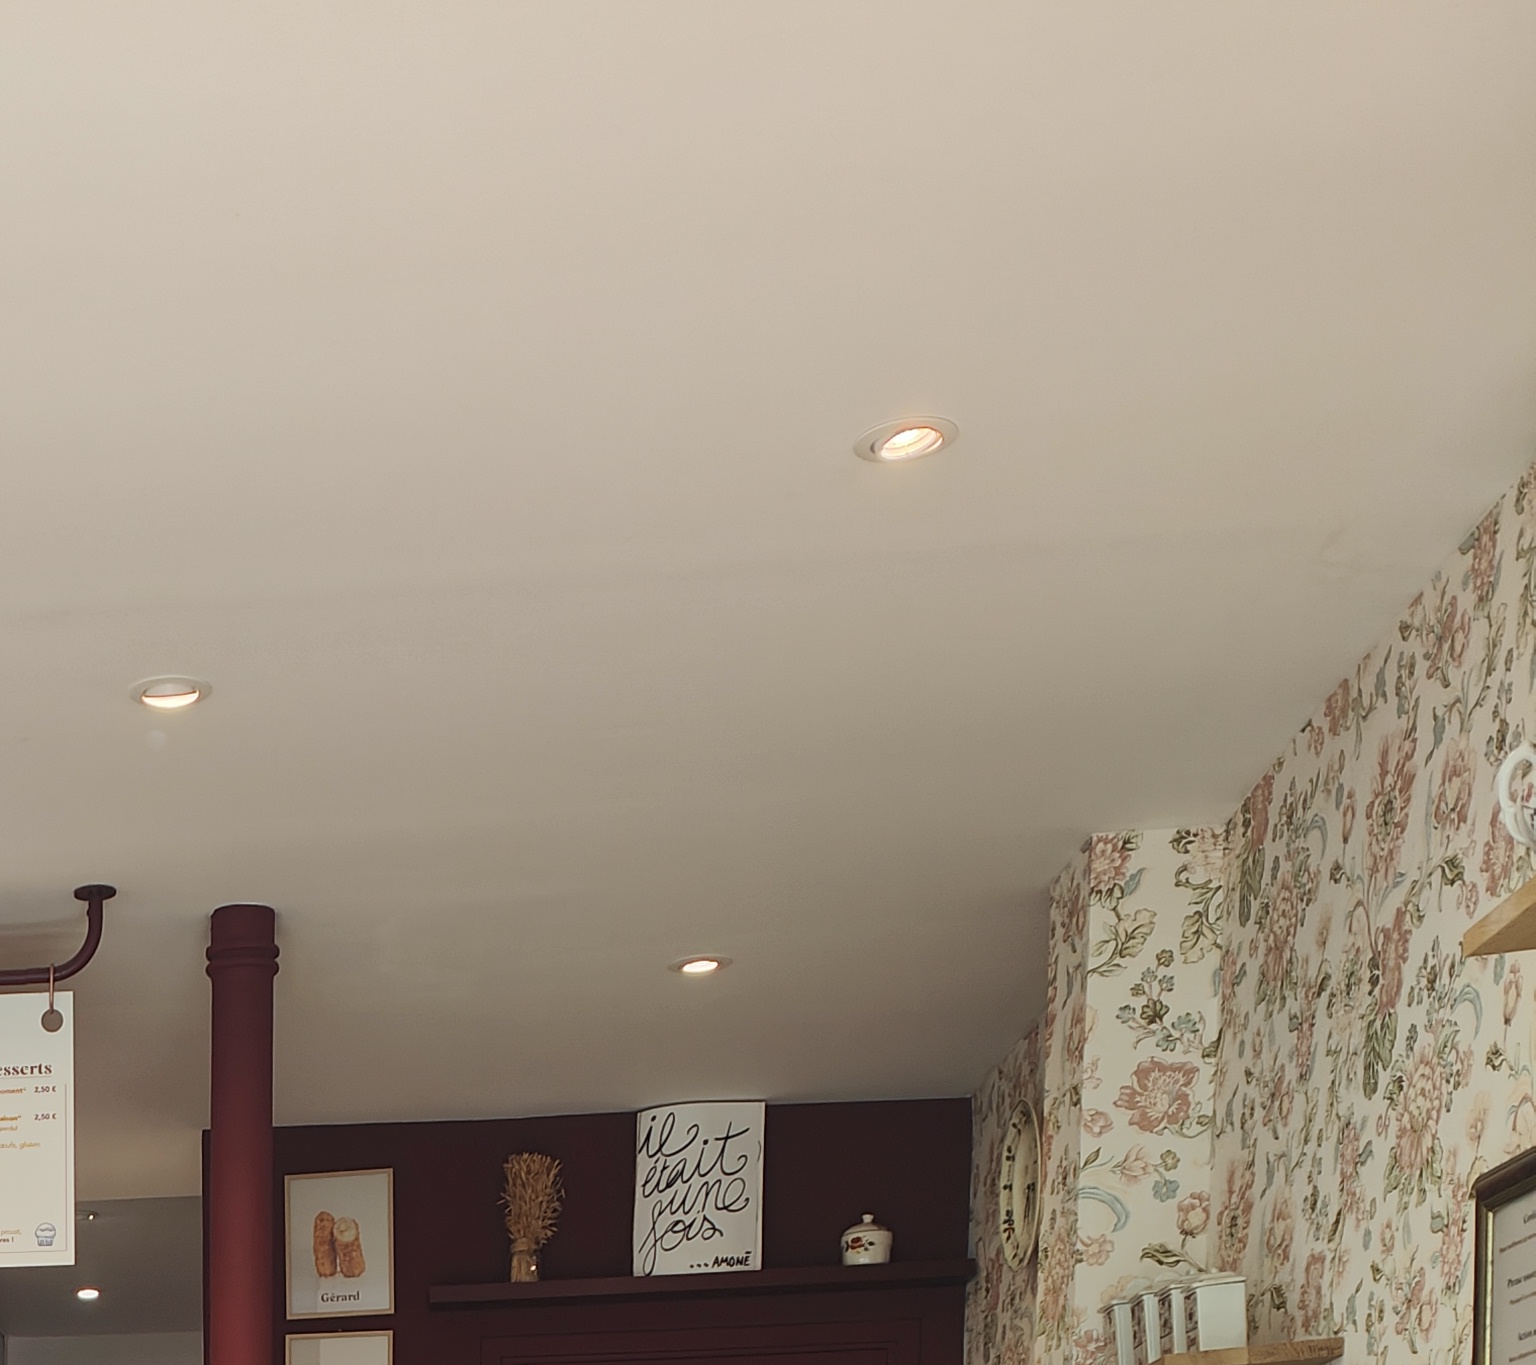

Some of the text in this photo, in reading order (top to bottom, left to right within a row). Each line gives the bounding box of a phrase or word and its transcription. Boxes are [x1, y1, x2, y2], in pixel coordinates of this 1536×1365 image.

[637, 1111, 700, 1158] il
[642, 1120, 751, 1199] était
[667, 1177, 751, 1215] une
[638, 1198, 724, 1276] fois
[320, 1291, 360, 1303] Gérard
